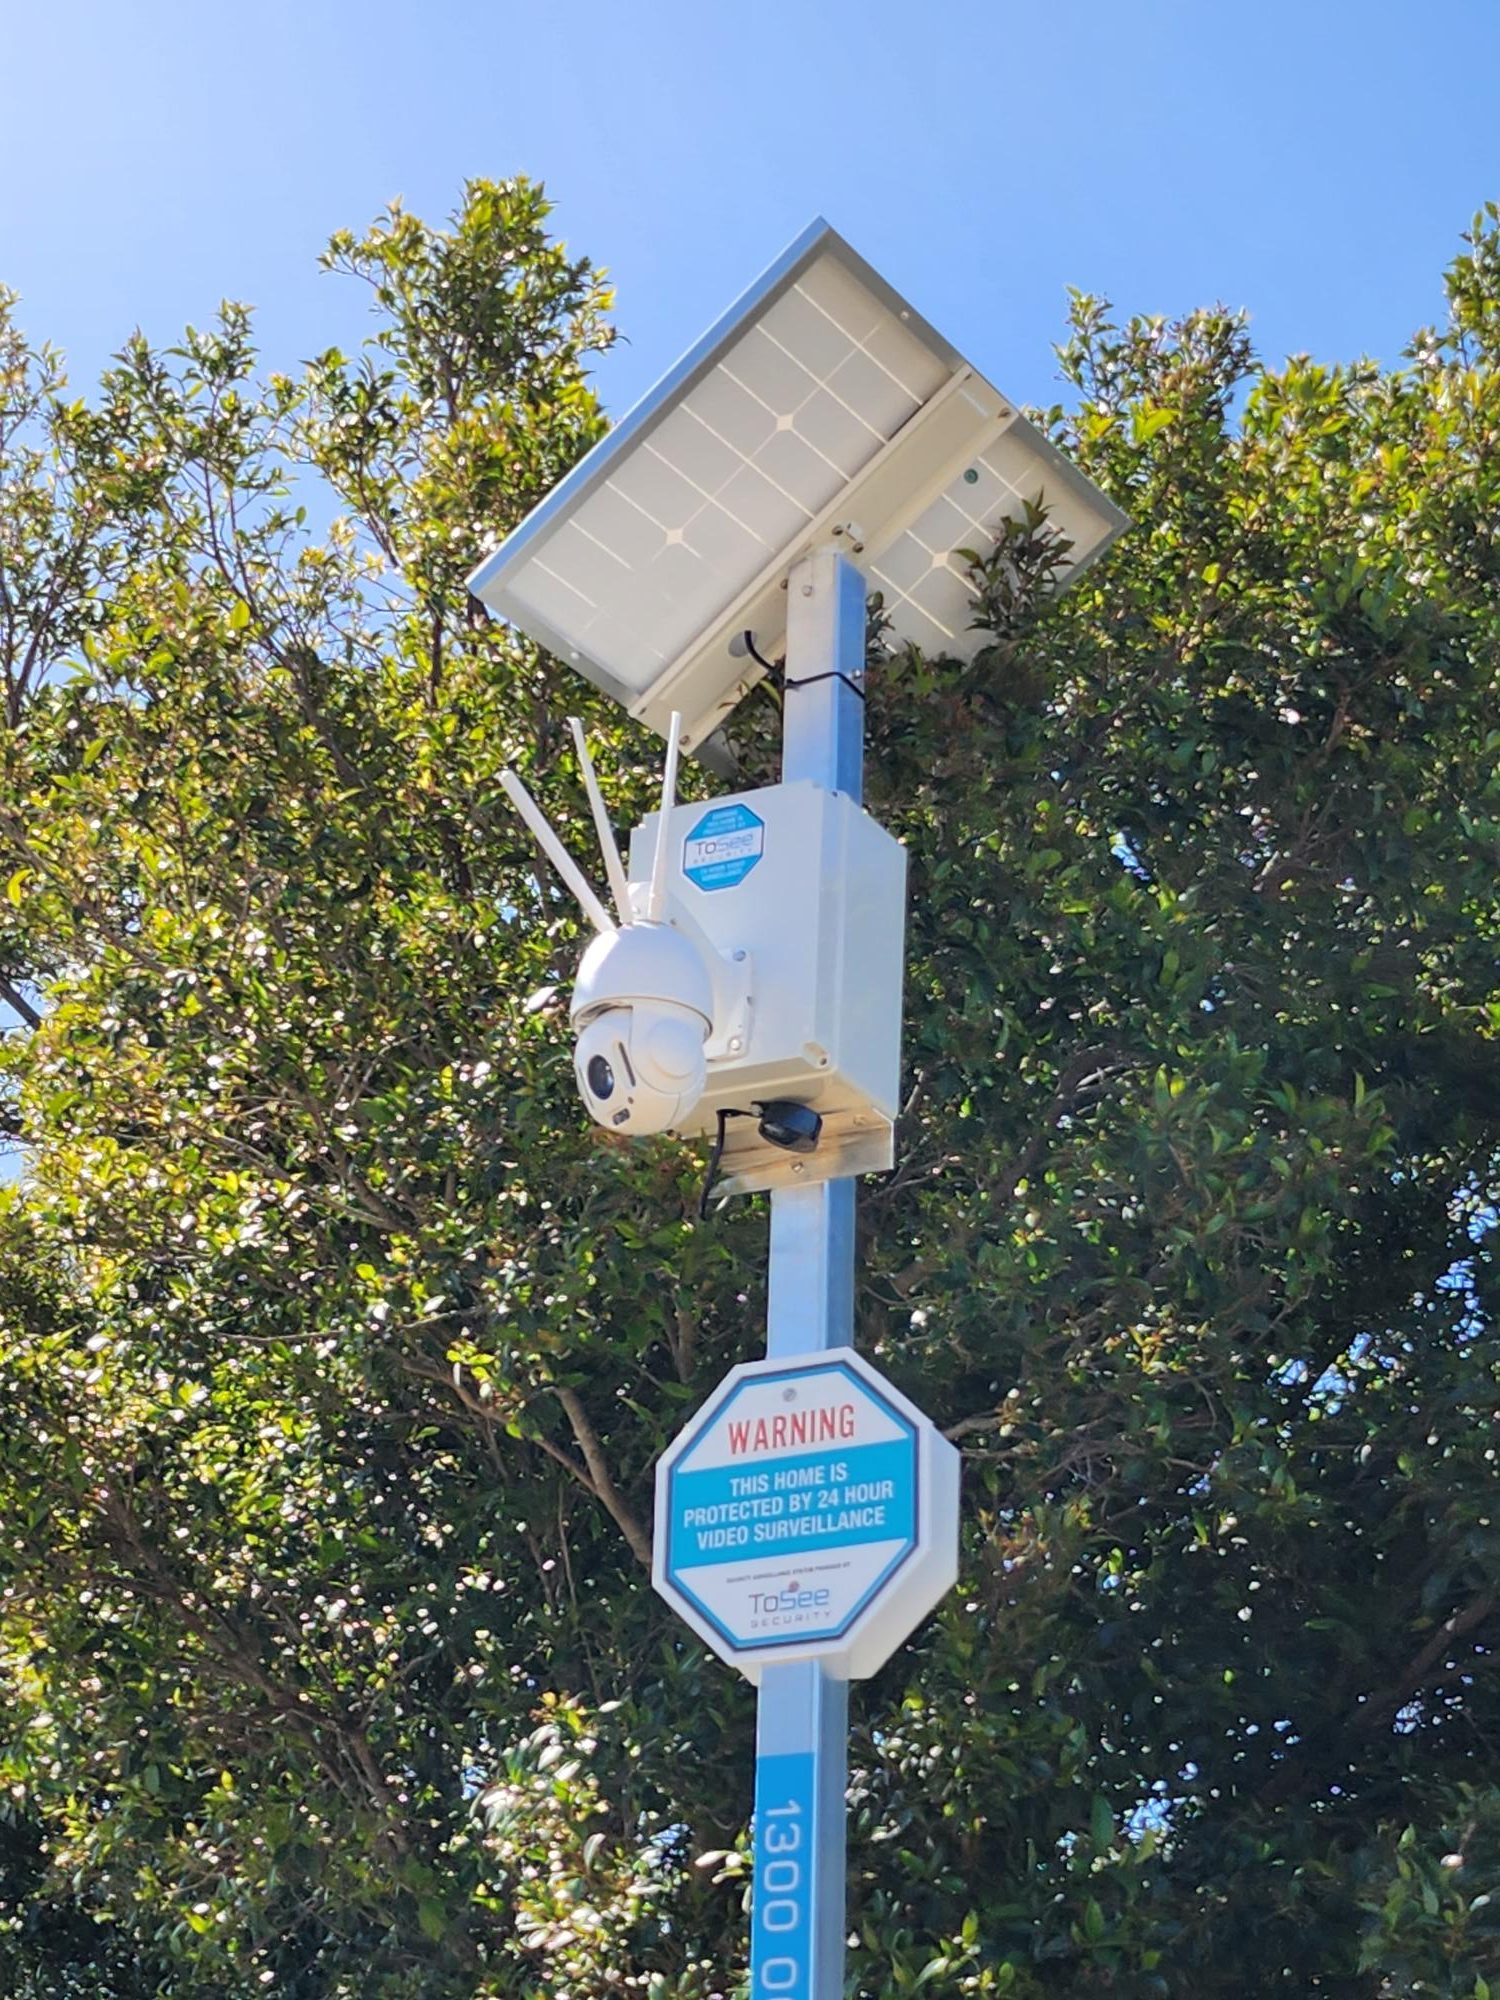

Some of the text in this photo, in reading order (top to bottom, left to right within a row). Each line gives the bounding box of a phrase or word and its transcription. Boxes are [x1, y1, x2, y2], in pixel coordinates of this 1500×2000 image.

[728, 1404, 855, 1455] WARNING
[730, 1463, 847, 1497] THIS HOME IS
[683, 1481, 894, 1528] PROTECTED BY 24 HOUR
[697, 1506, 885, 1550] VIDEO SURVEILLANCE
[749, 1588, 830, 1615] ToSee
[750, 1611, 831, 1629] SECURITY
[760, 1799, 802, 2000] 1300 0
